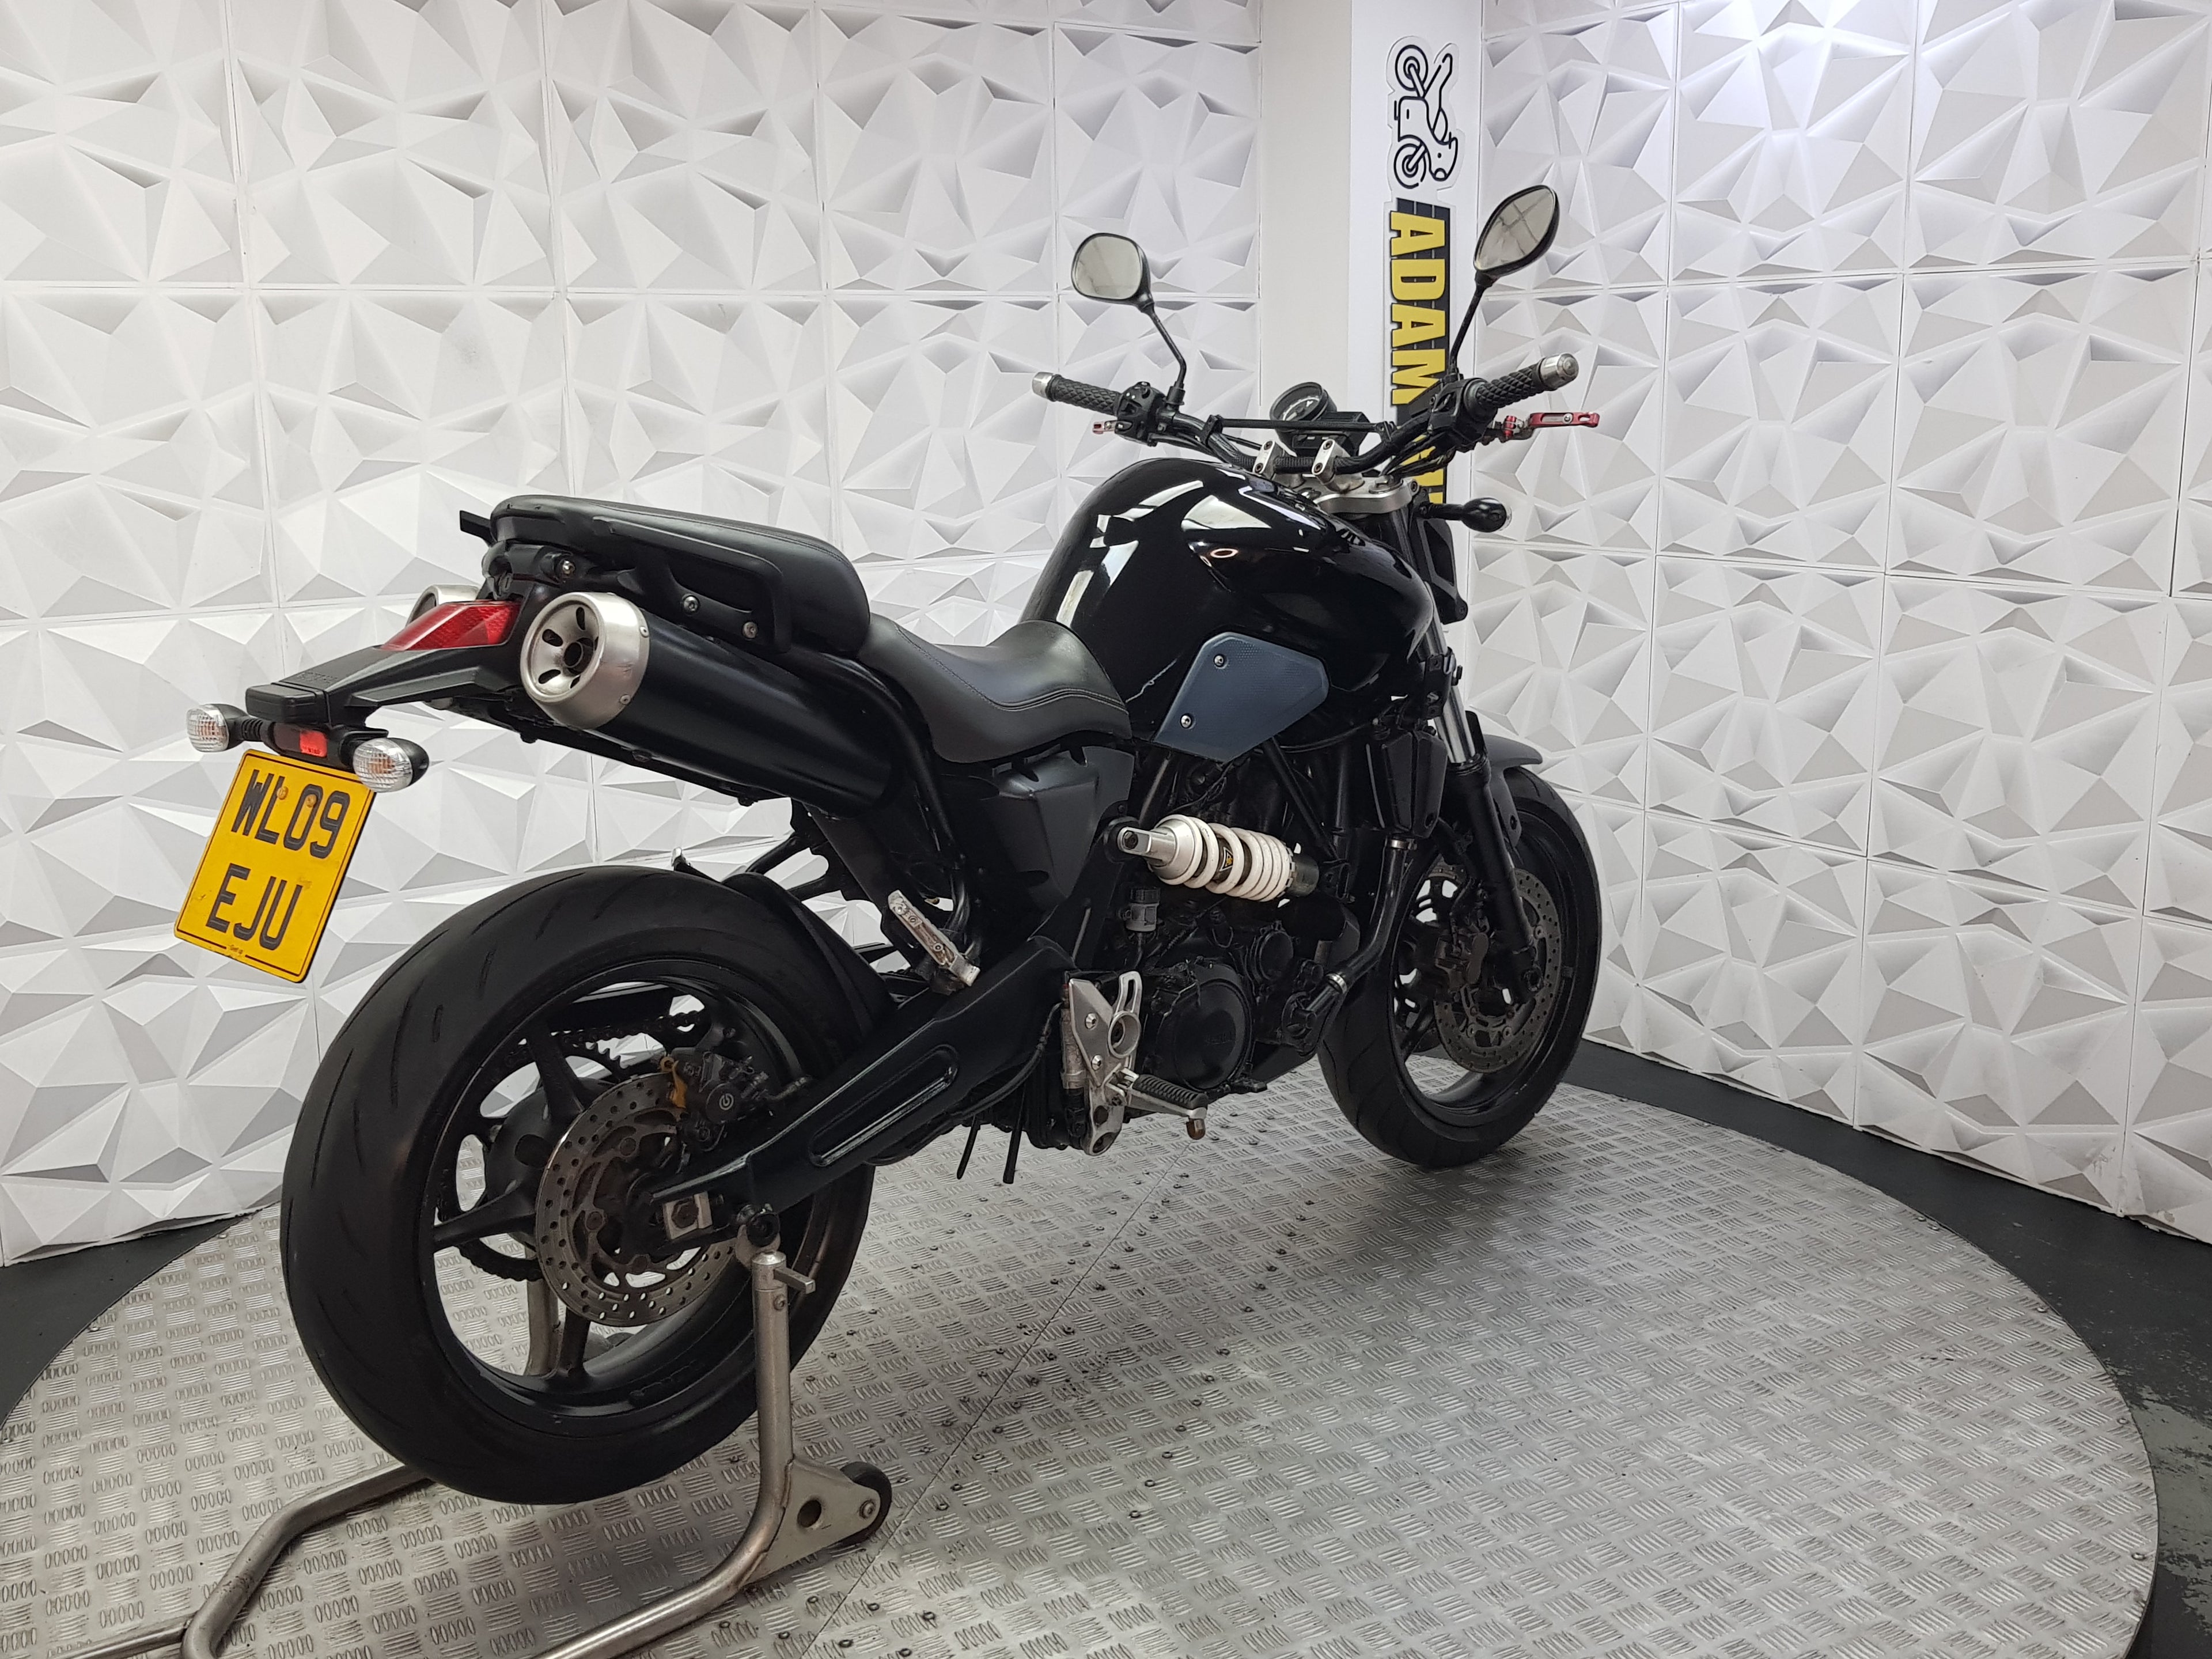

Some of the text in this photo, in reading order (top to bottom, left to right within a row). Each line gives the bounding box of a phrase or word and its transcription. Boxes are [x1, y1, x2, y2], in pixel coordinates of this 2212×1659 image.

[1391, 210, 1446, 404] ADAM
[231, 769, 350, 859] WL09
[206, 863, 303, 950] EJU
